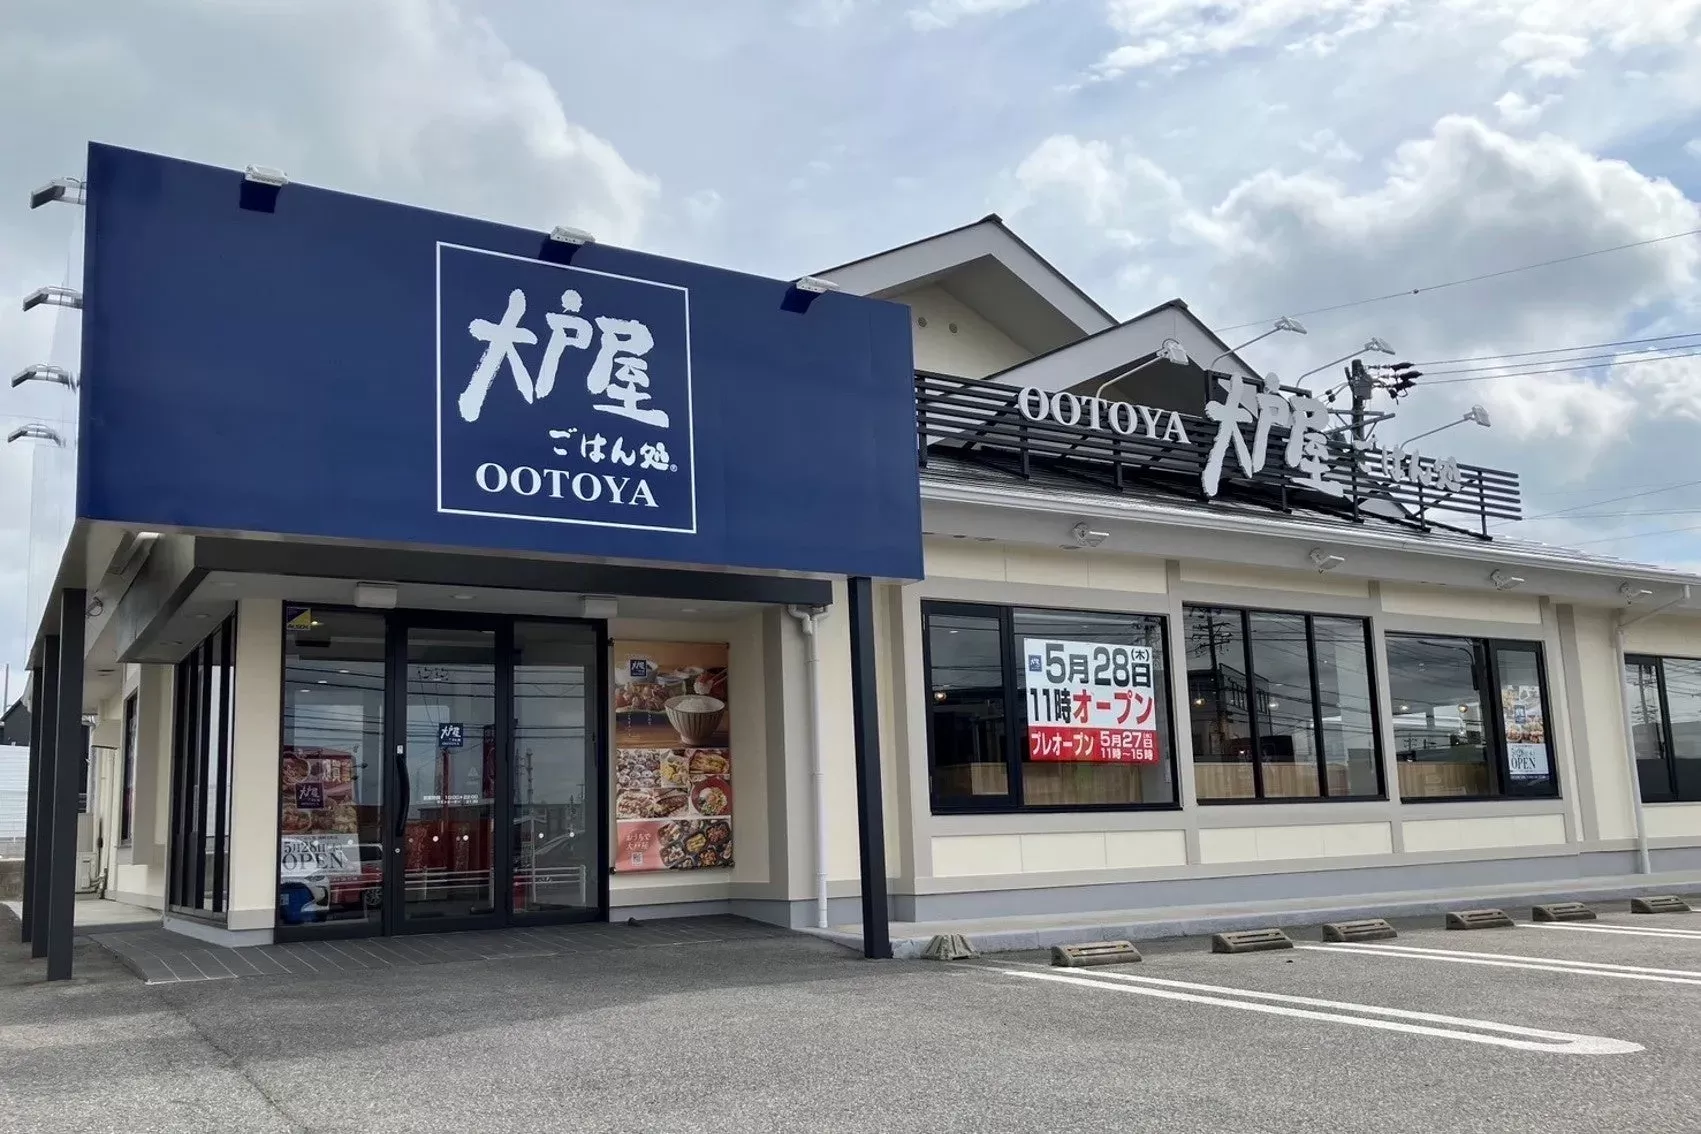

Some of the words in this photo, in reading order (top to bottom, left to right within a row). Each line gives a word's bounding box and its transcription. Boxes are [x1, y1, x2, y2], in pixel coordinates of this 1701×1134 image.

[458, 288, 670, 428] 大戸屋
[1018, 387, 1191, 444] OOTOYA
[1202, 372, 1344, 497] 大戸屋
[548, 427, 671, 472] ごはん処
[475, 462, 660, 508] OOTOYA
[1031, 731, 1094, 756] プレオープン
[1511, 757, 1536, 770] OPEN
[281, 851, 344, 871] OPEN
